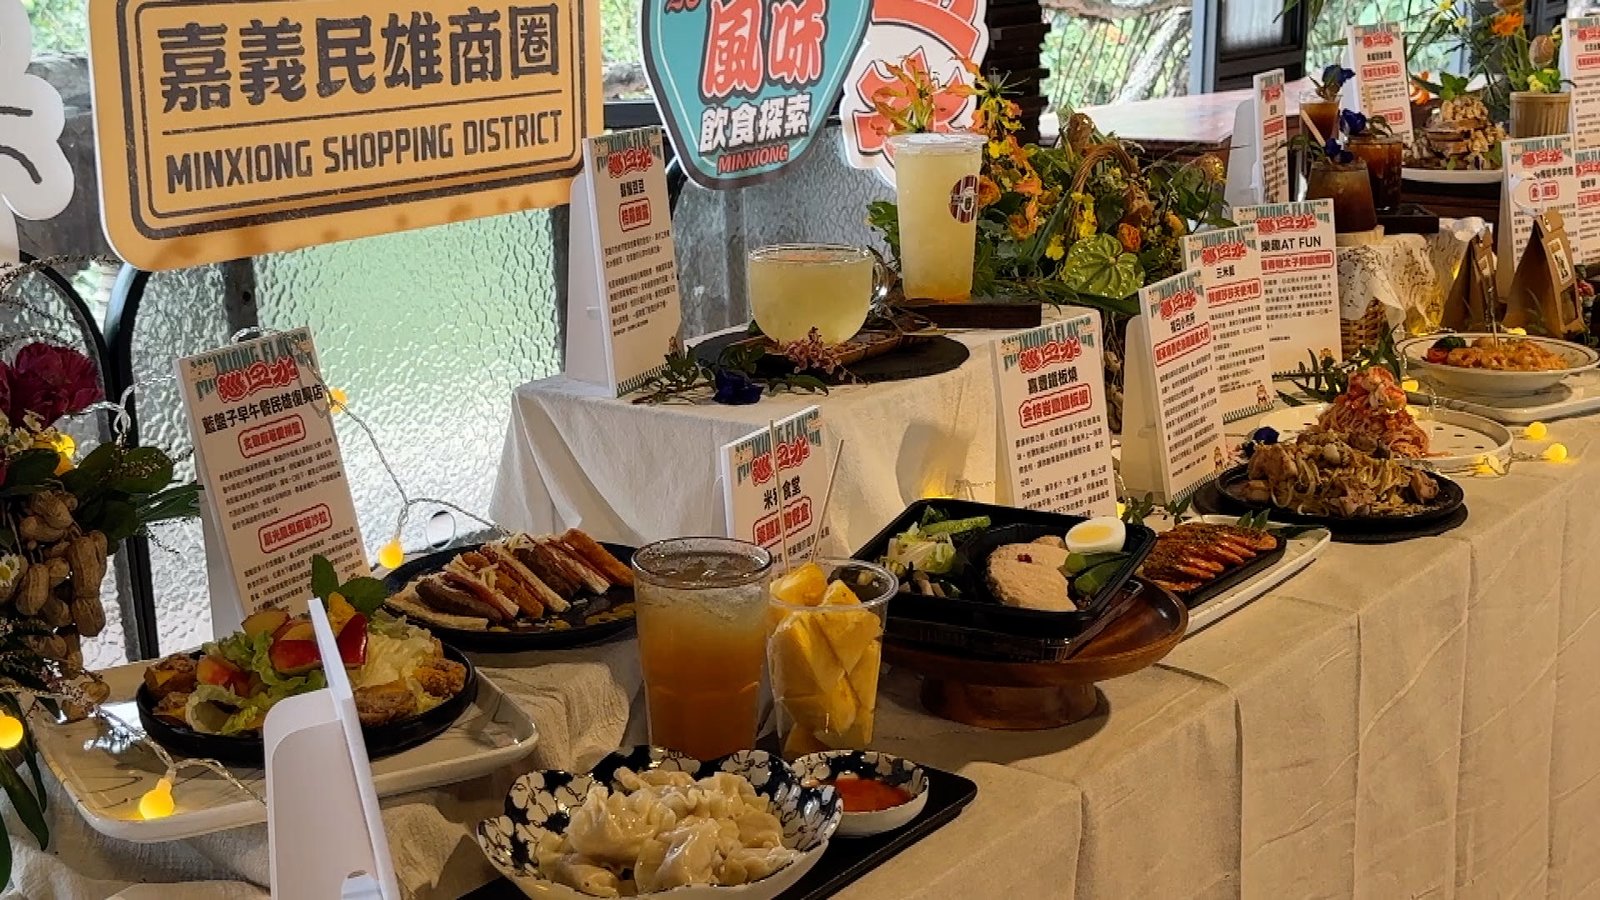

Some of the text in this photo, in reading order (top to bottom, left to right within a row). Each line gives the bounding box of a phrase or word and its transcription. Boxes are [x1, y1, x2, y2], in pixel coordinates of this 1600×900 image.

[158, 4, 560, 114] 嘉義民雄商圈
[702, 0, 826, 97] 風味
[166, 110, 562, 194] MINXIONG SHOPPING DISTRICT
[700, 94, 812, 153] 飲食探索
[717, 145, 789, 174] MINXIONG
[1299, 236, 1321, 248] FUN
